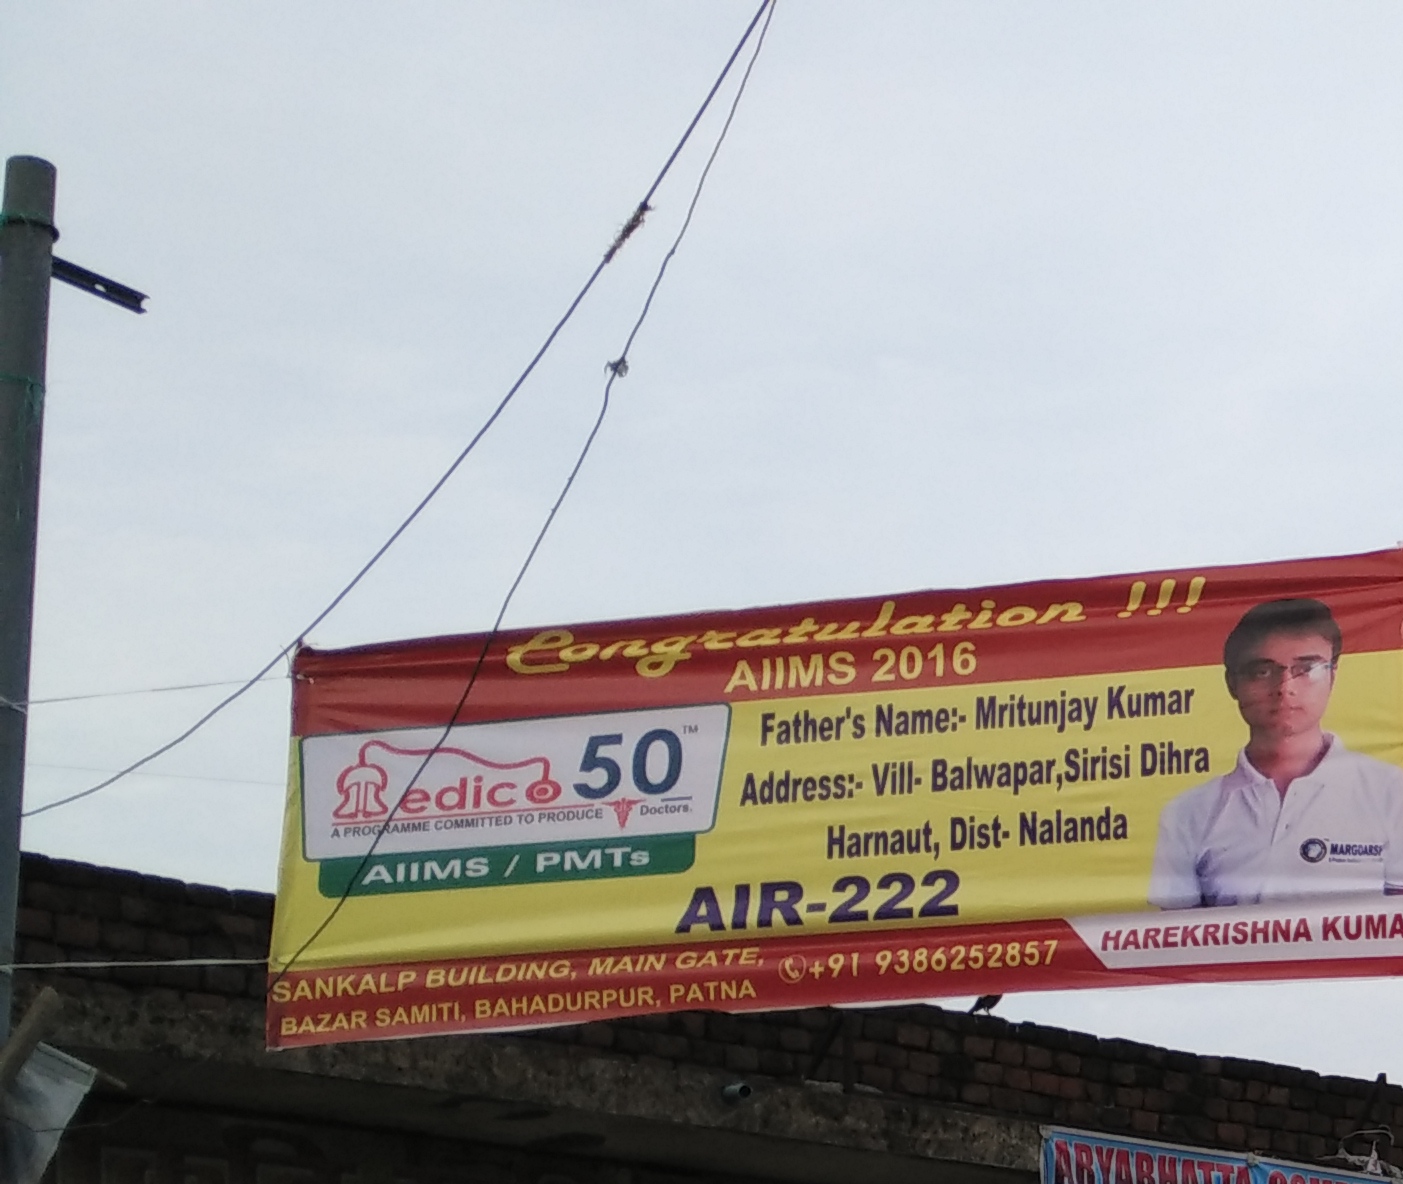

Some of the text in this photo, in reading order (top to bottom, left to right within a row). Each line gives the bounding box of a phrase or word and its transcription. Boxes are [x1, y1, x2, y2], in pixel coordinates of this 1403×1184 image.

[507, 576, 1206, 677] Congratulation !!!
[724, 641, 977, 694] AIIMS 2016
[675, 869, 961, 933] AIR-222
[1101, 917, 1308, 952] HAREKRISHNA
